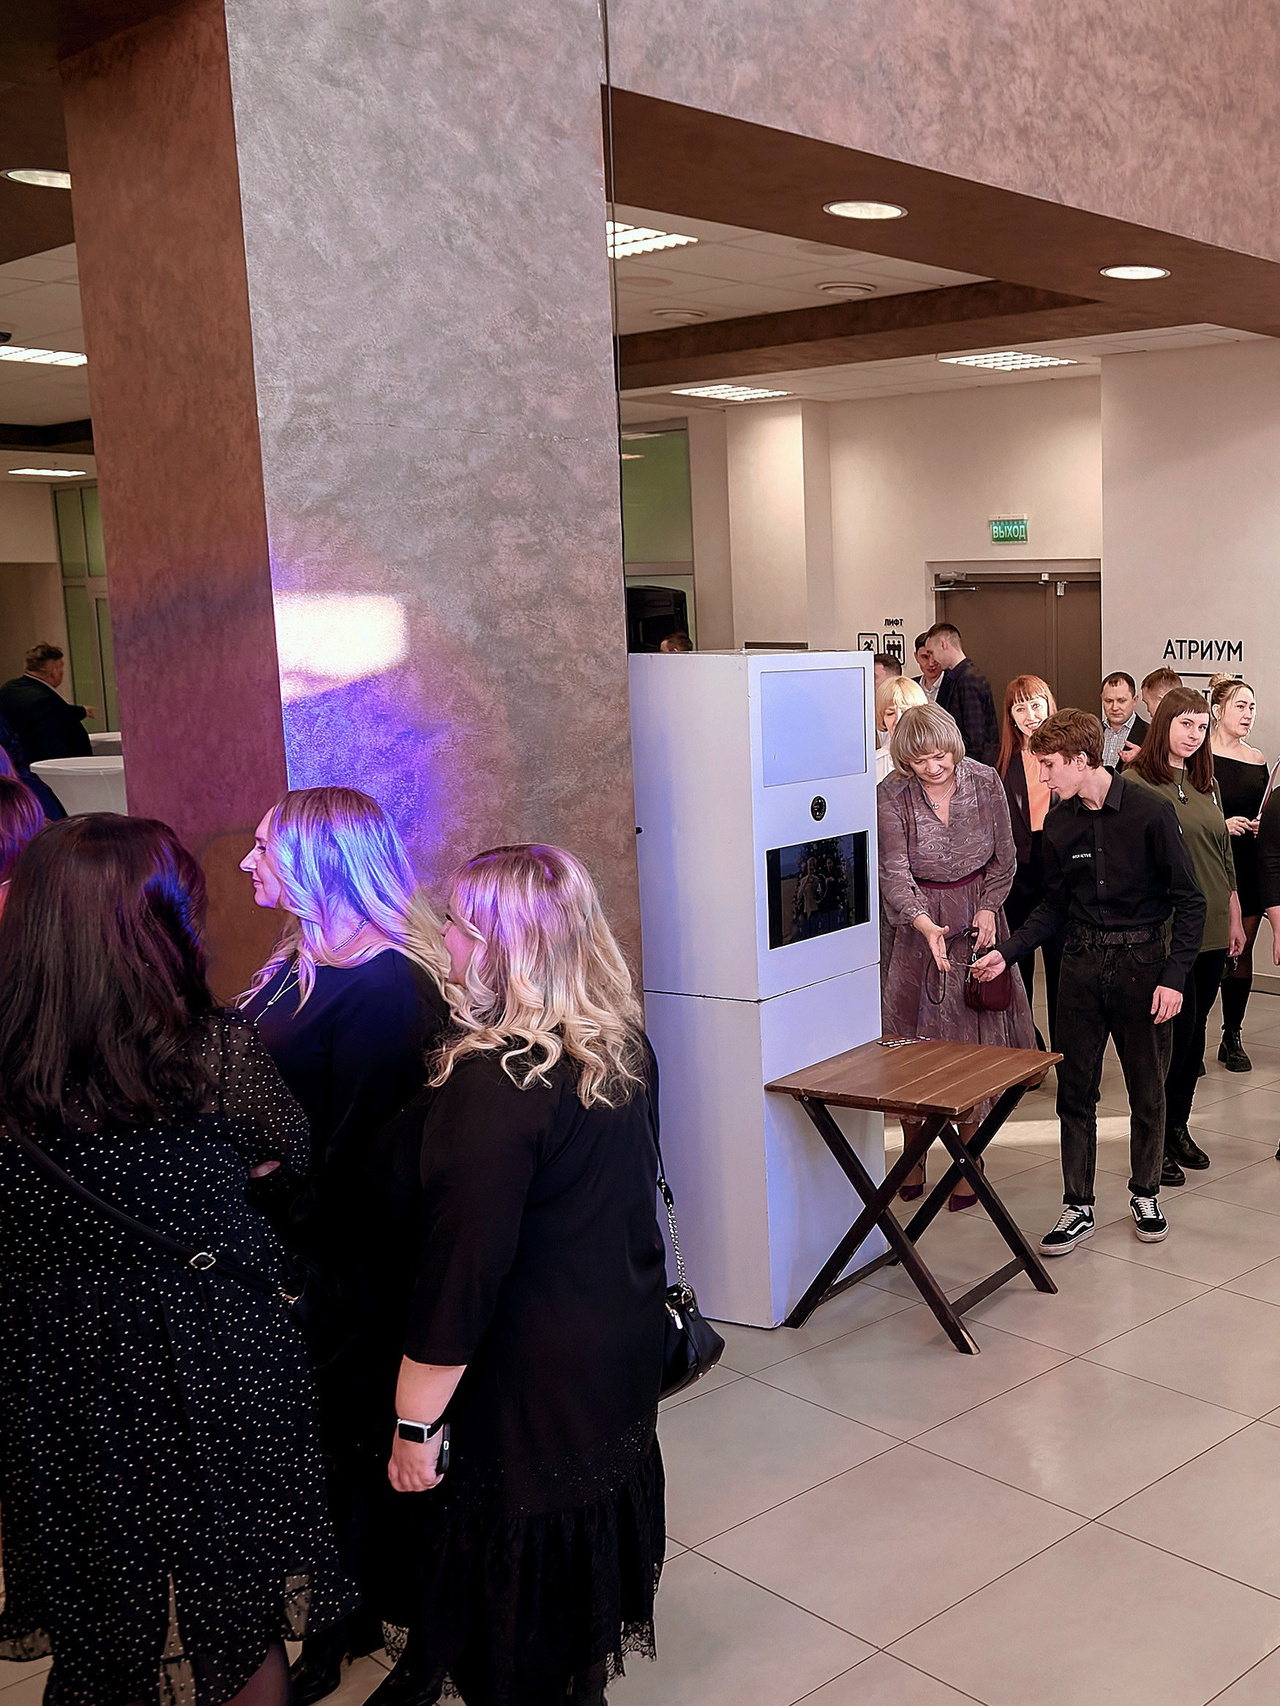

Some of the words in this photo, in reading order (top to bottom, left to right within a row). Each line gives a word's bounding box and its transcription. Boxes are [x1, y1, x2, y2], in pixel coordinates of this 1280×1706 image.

[992, 525, 1026, 540] ВЫХОД
[884, 618, 904, 627] ЛИФТ
[1163, 639, 1243, 662] АТРИУМ
